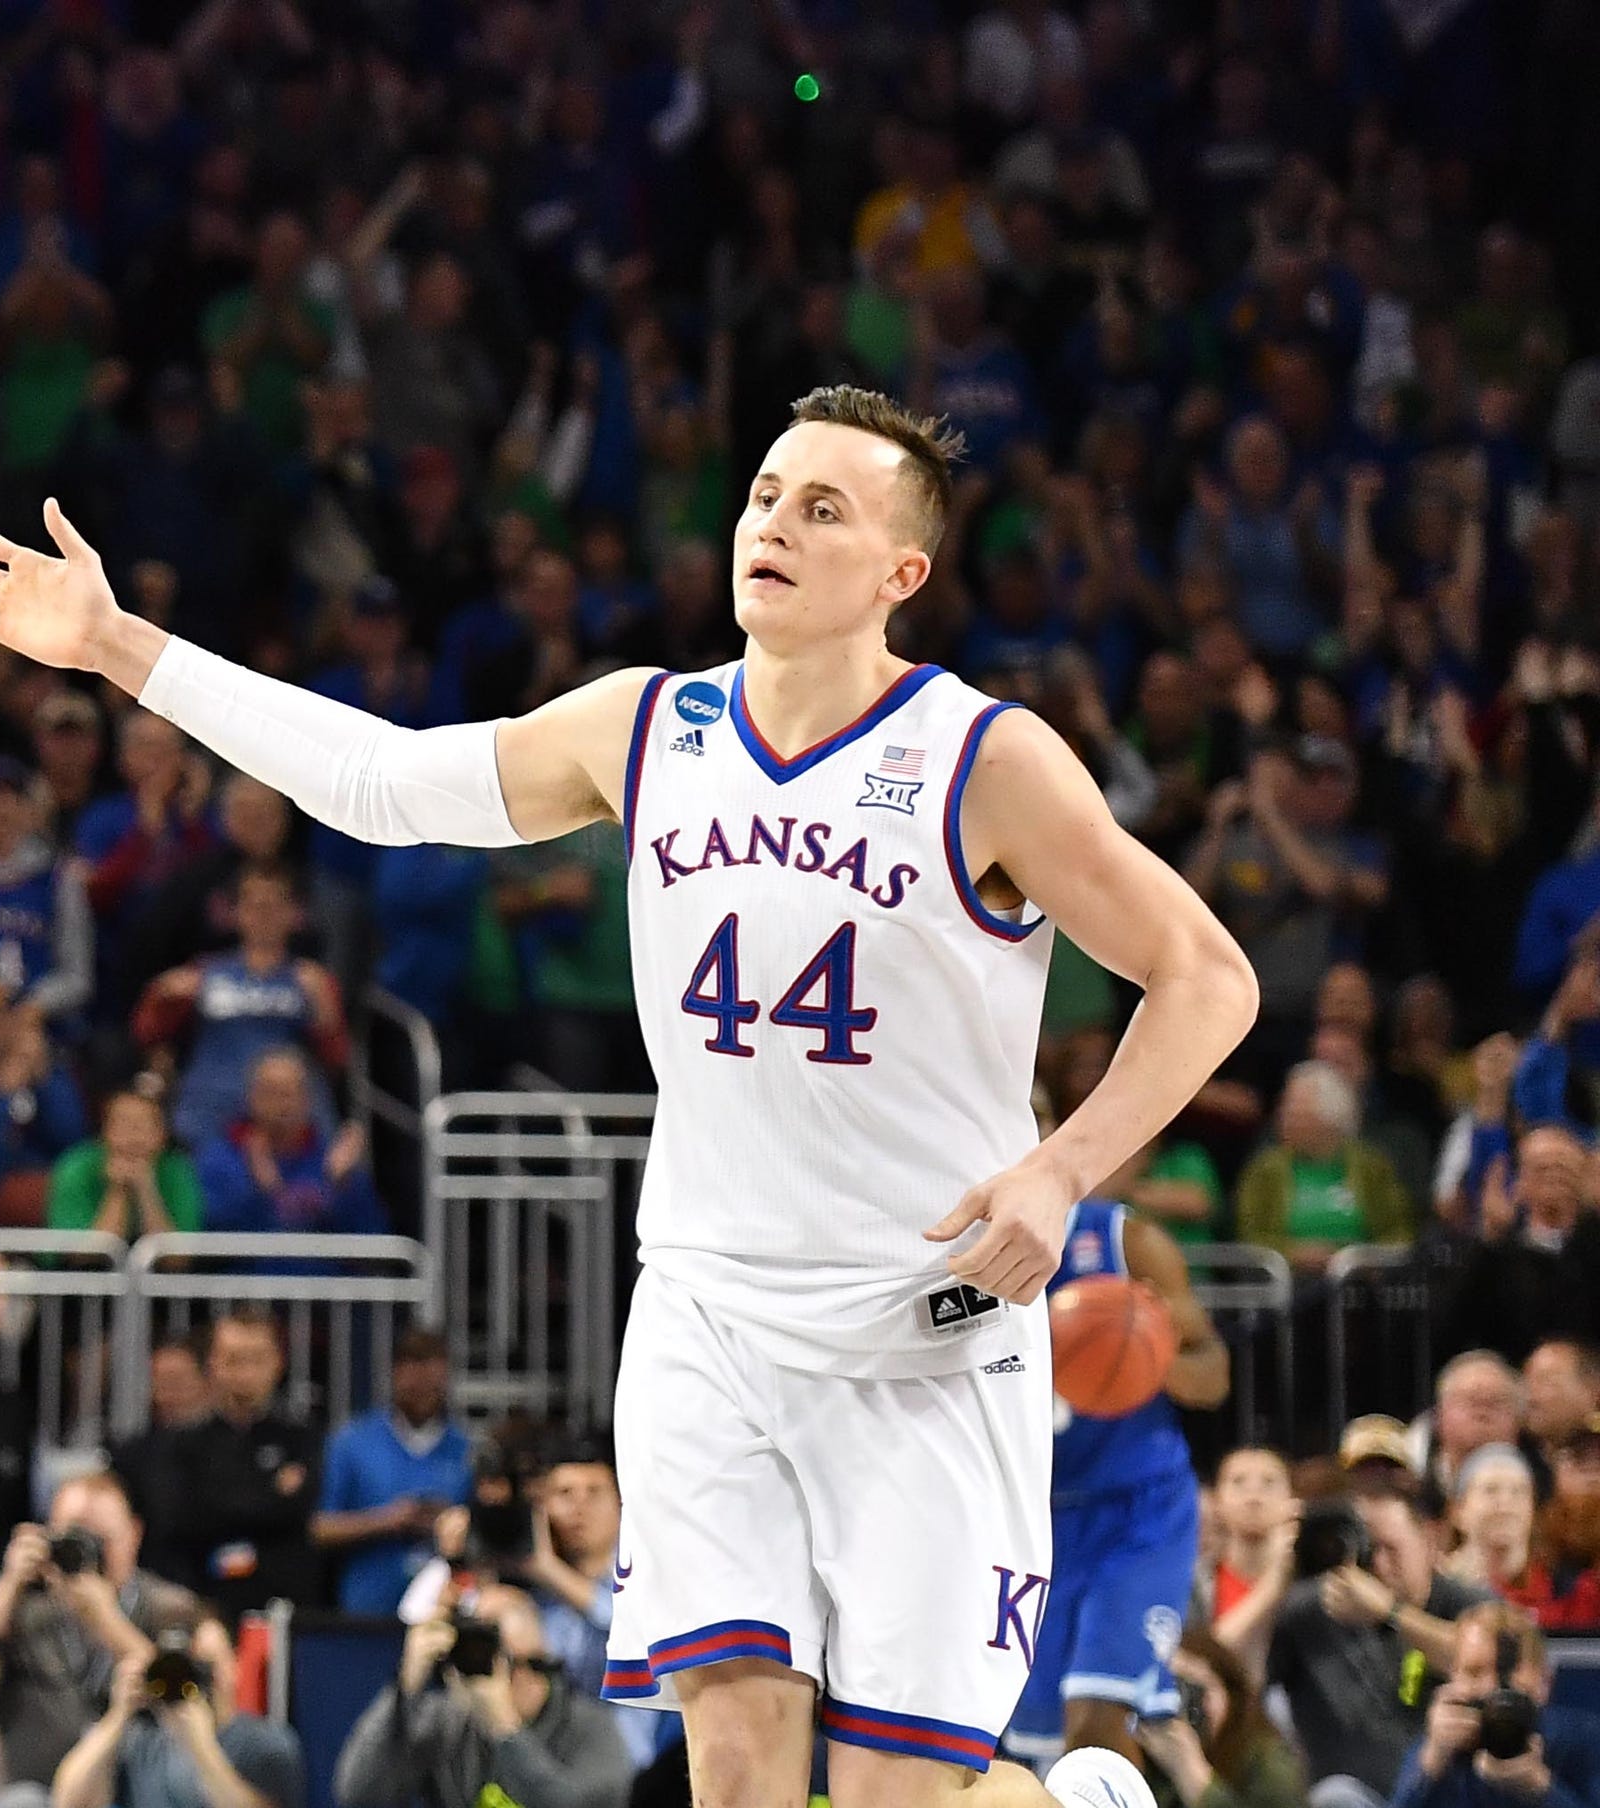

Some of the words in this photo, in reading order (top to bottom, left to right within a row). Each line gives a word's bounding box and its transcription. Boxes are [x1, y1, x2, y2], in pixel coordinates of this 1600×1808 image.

[678, 696, 721, 719] NCAA
[651, 814, 920, 909] KANSAS
[681, 912, 878, 1065] 44
[984, 1360, 1026, 1375] adidas
